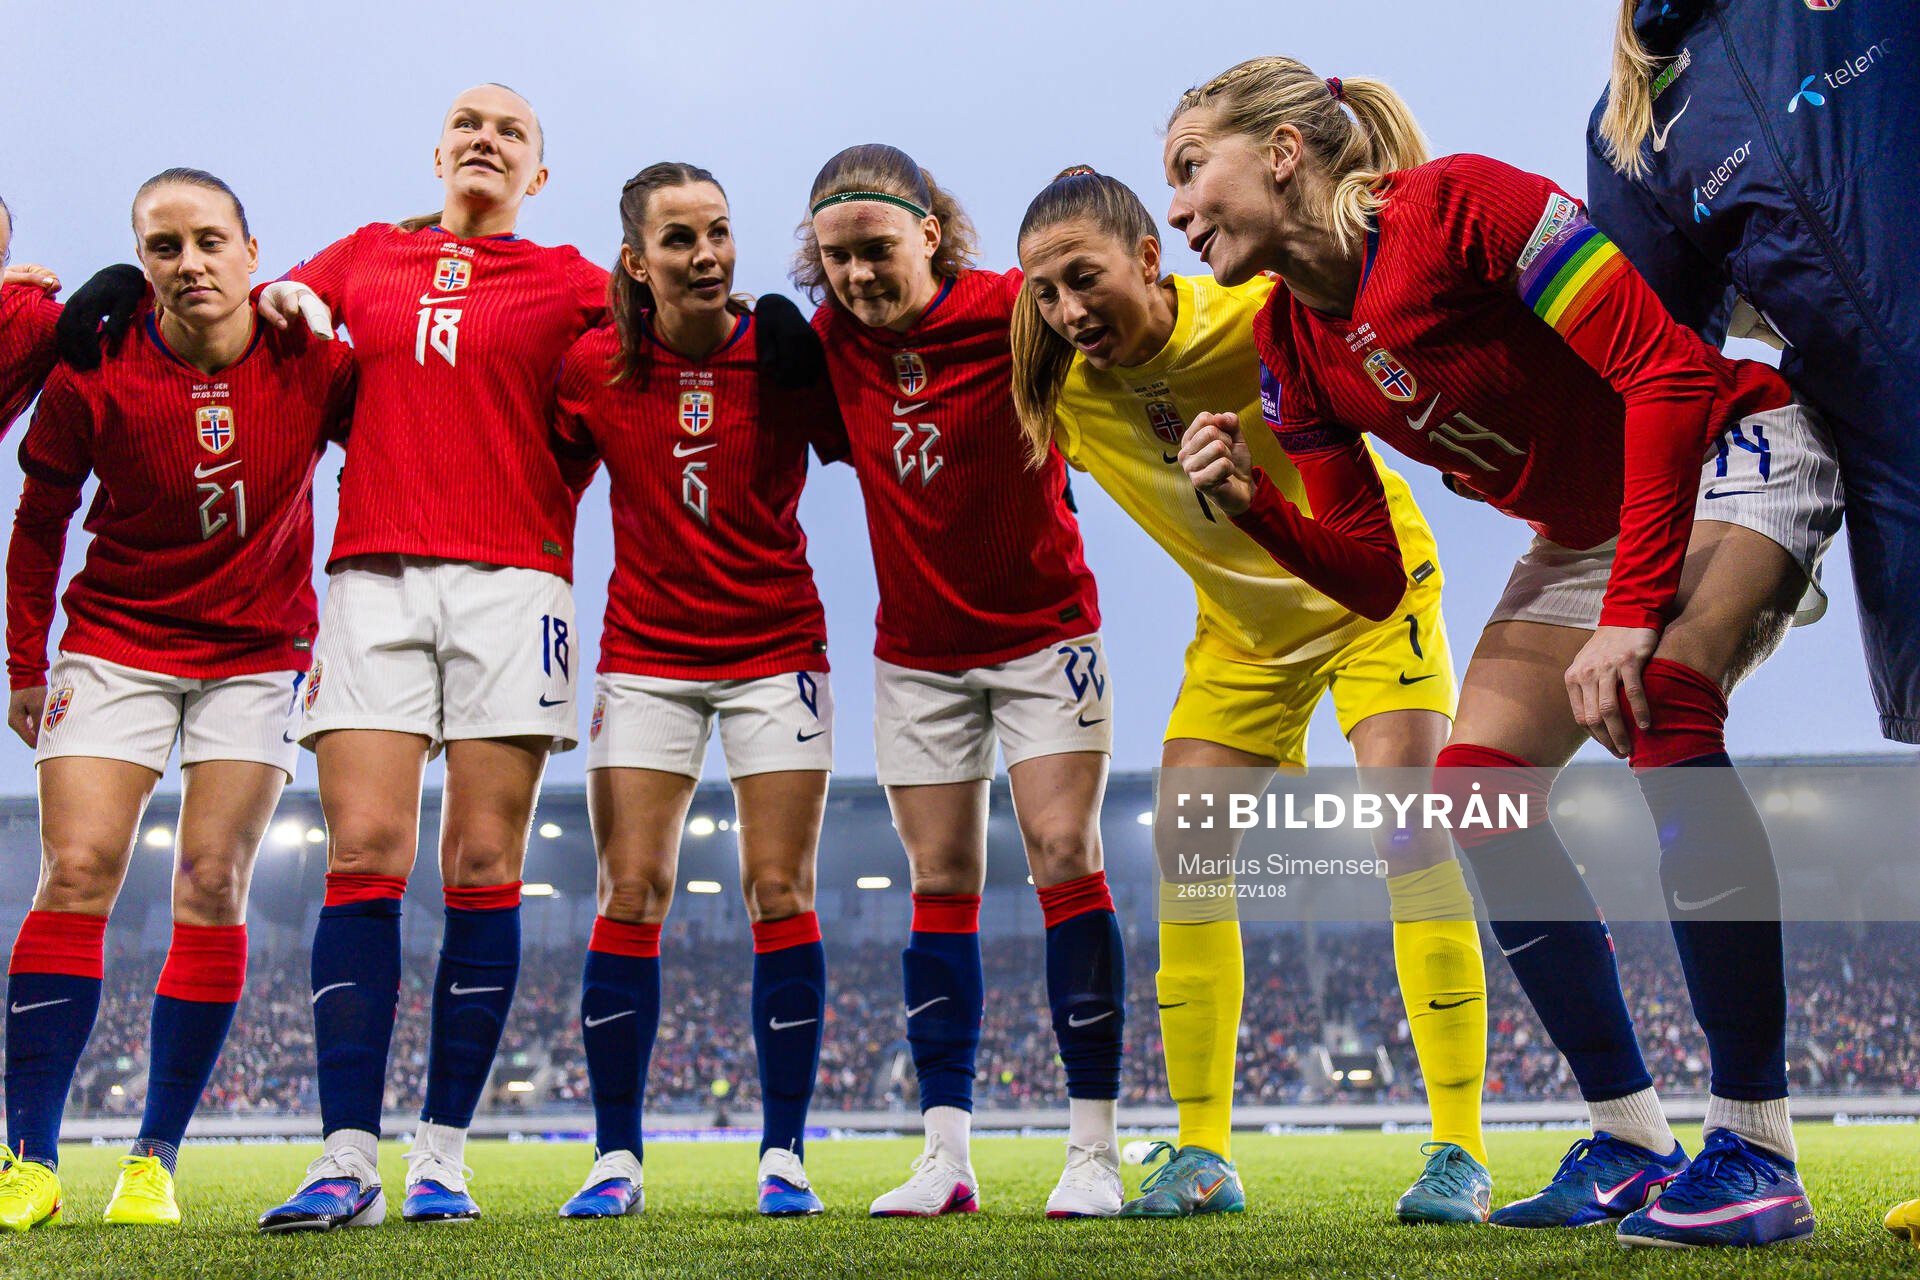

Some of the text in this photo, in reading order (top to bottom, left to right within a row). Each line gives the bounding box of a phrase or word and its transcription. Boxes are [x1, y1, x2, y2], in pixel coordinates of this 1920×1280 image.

[1701, 140, 1752, 200] telenor
[1531, 197, 1570, 261] UNDATION
[415, 307, 463, 368] 18
[1358, 322, 1371, 335] GER
[892, 422, 944, 487] 22
[1429, 411, 1527, 472] 14
[1714, 423, 1772, 484] 14
[196, 480, 247, 540] 21
[682, 462, 709, 526] 6
[540, 614, 569, 686] 18
[1403, 613, 1424, 661] 1
[1057, 646, 1105, 704] 22
